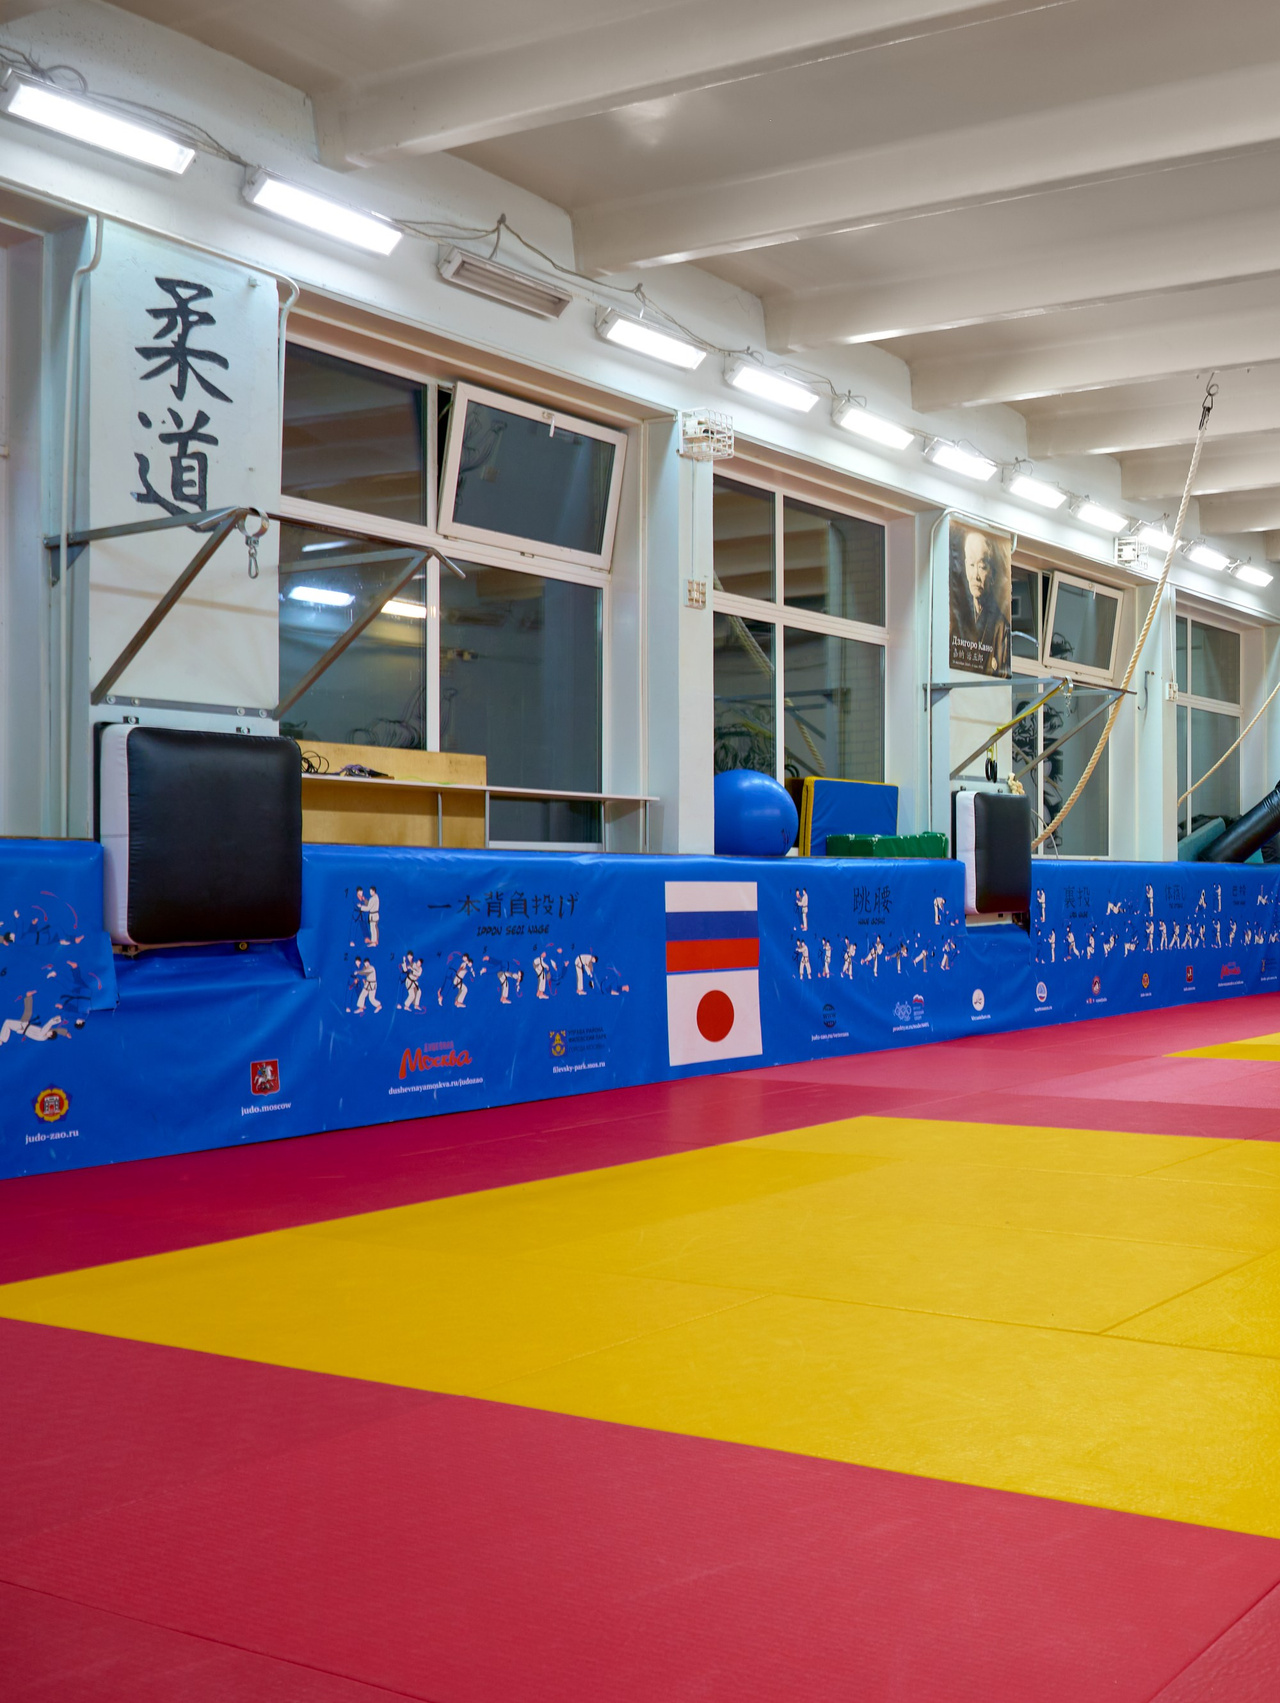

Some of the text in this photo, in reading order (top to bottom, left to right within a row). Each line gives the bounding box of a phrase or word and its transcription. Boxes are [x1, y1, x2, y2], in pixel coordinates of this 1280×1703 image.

[131, 276, 233, 533] 柔道
[427, 890, 580, 919] 一本背負投げ
[477, 924, 550, 936] IPPON SEOI NAGE
[399, 1047, 473, 1080] Москва
[388, 1077, 484, 1095] dushevnayamoskva.ru/judozao
[241, 1101, 292, 1116] judo.moscow
[25, 1129, 80, 1145] judo-zao.ru
